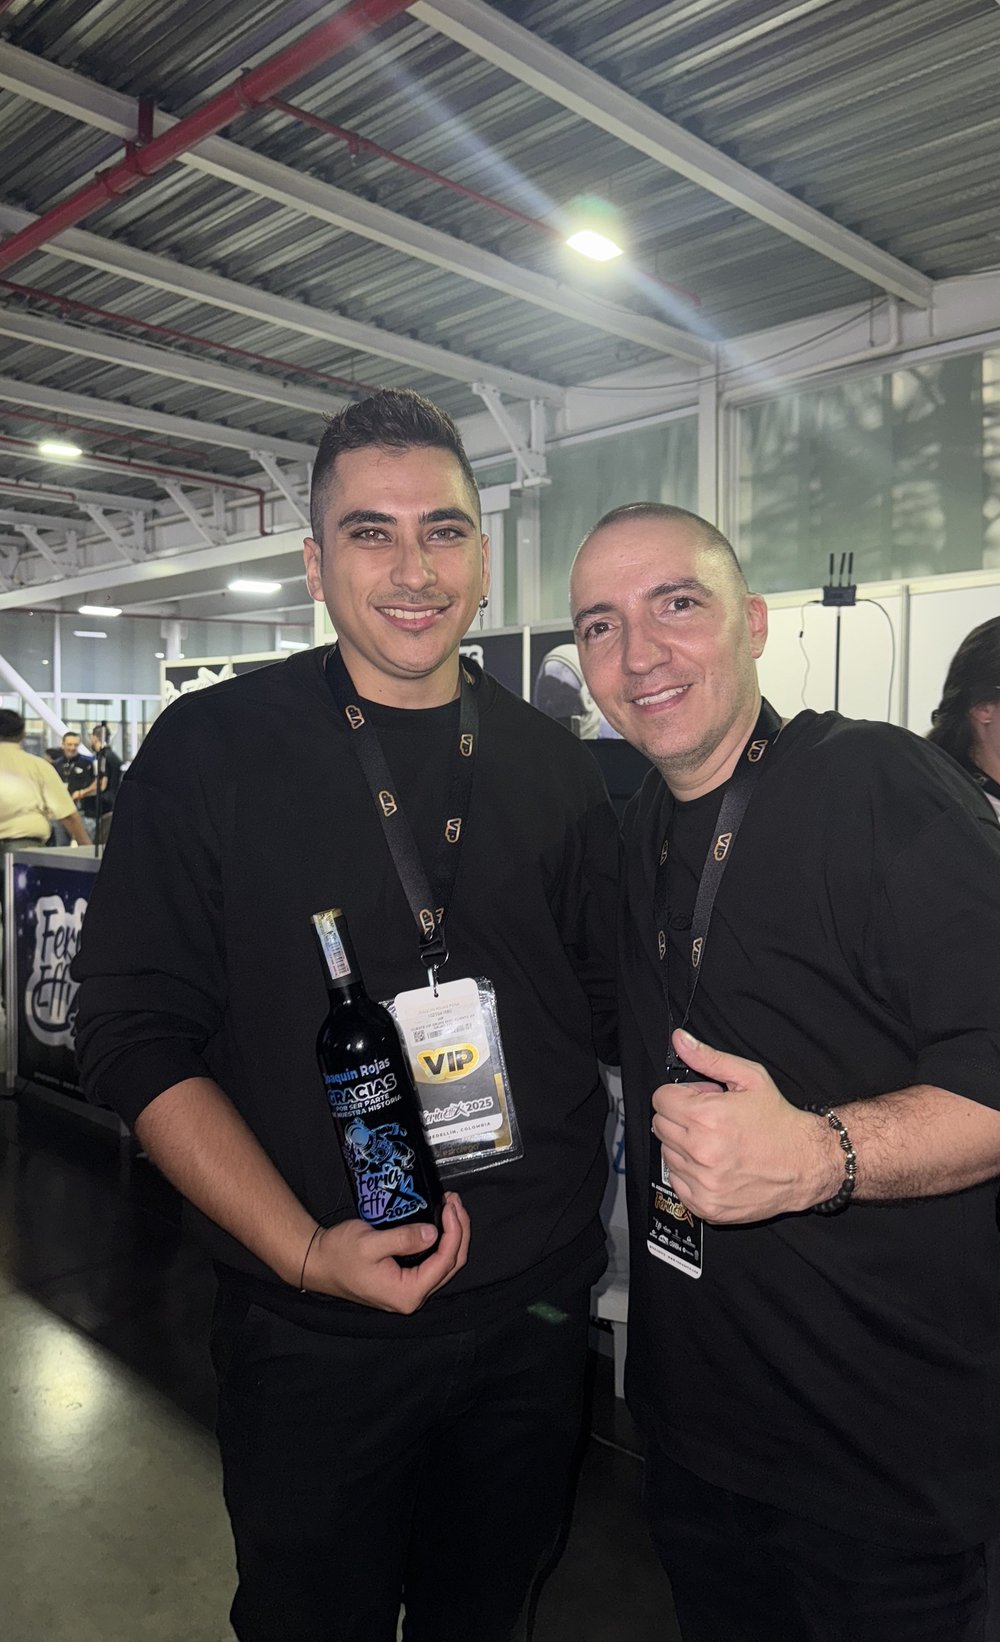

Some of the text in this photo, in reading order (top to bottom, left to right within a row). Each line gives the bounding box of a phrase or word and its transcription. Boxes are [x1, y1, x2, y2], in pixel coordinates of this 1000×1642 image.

[42, 908, 84, 962] Feri
[360, 1058, 390, 1077] Rojas
[423, 1049, 474, 1076] VIP
[328, 1073, 397, 1106] GRACIAS
[336, 1093, 390, 1112] POR SER PARTE
[337, 1103, 367, 1118] NUESTRA
[466, 1098, 492, 1112] 2025
[460, 1121, 491, 1133] COLOMBIA
[359, 1164, 401, 1195] Feria
[386, 1200, 418, 1219] 2025
